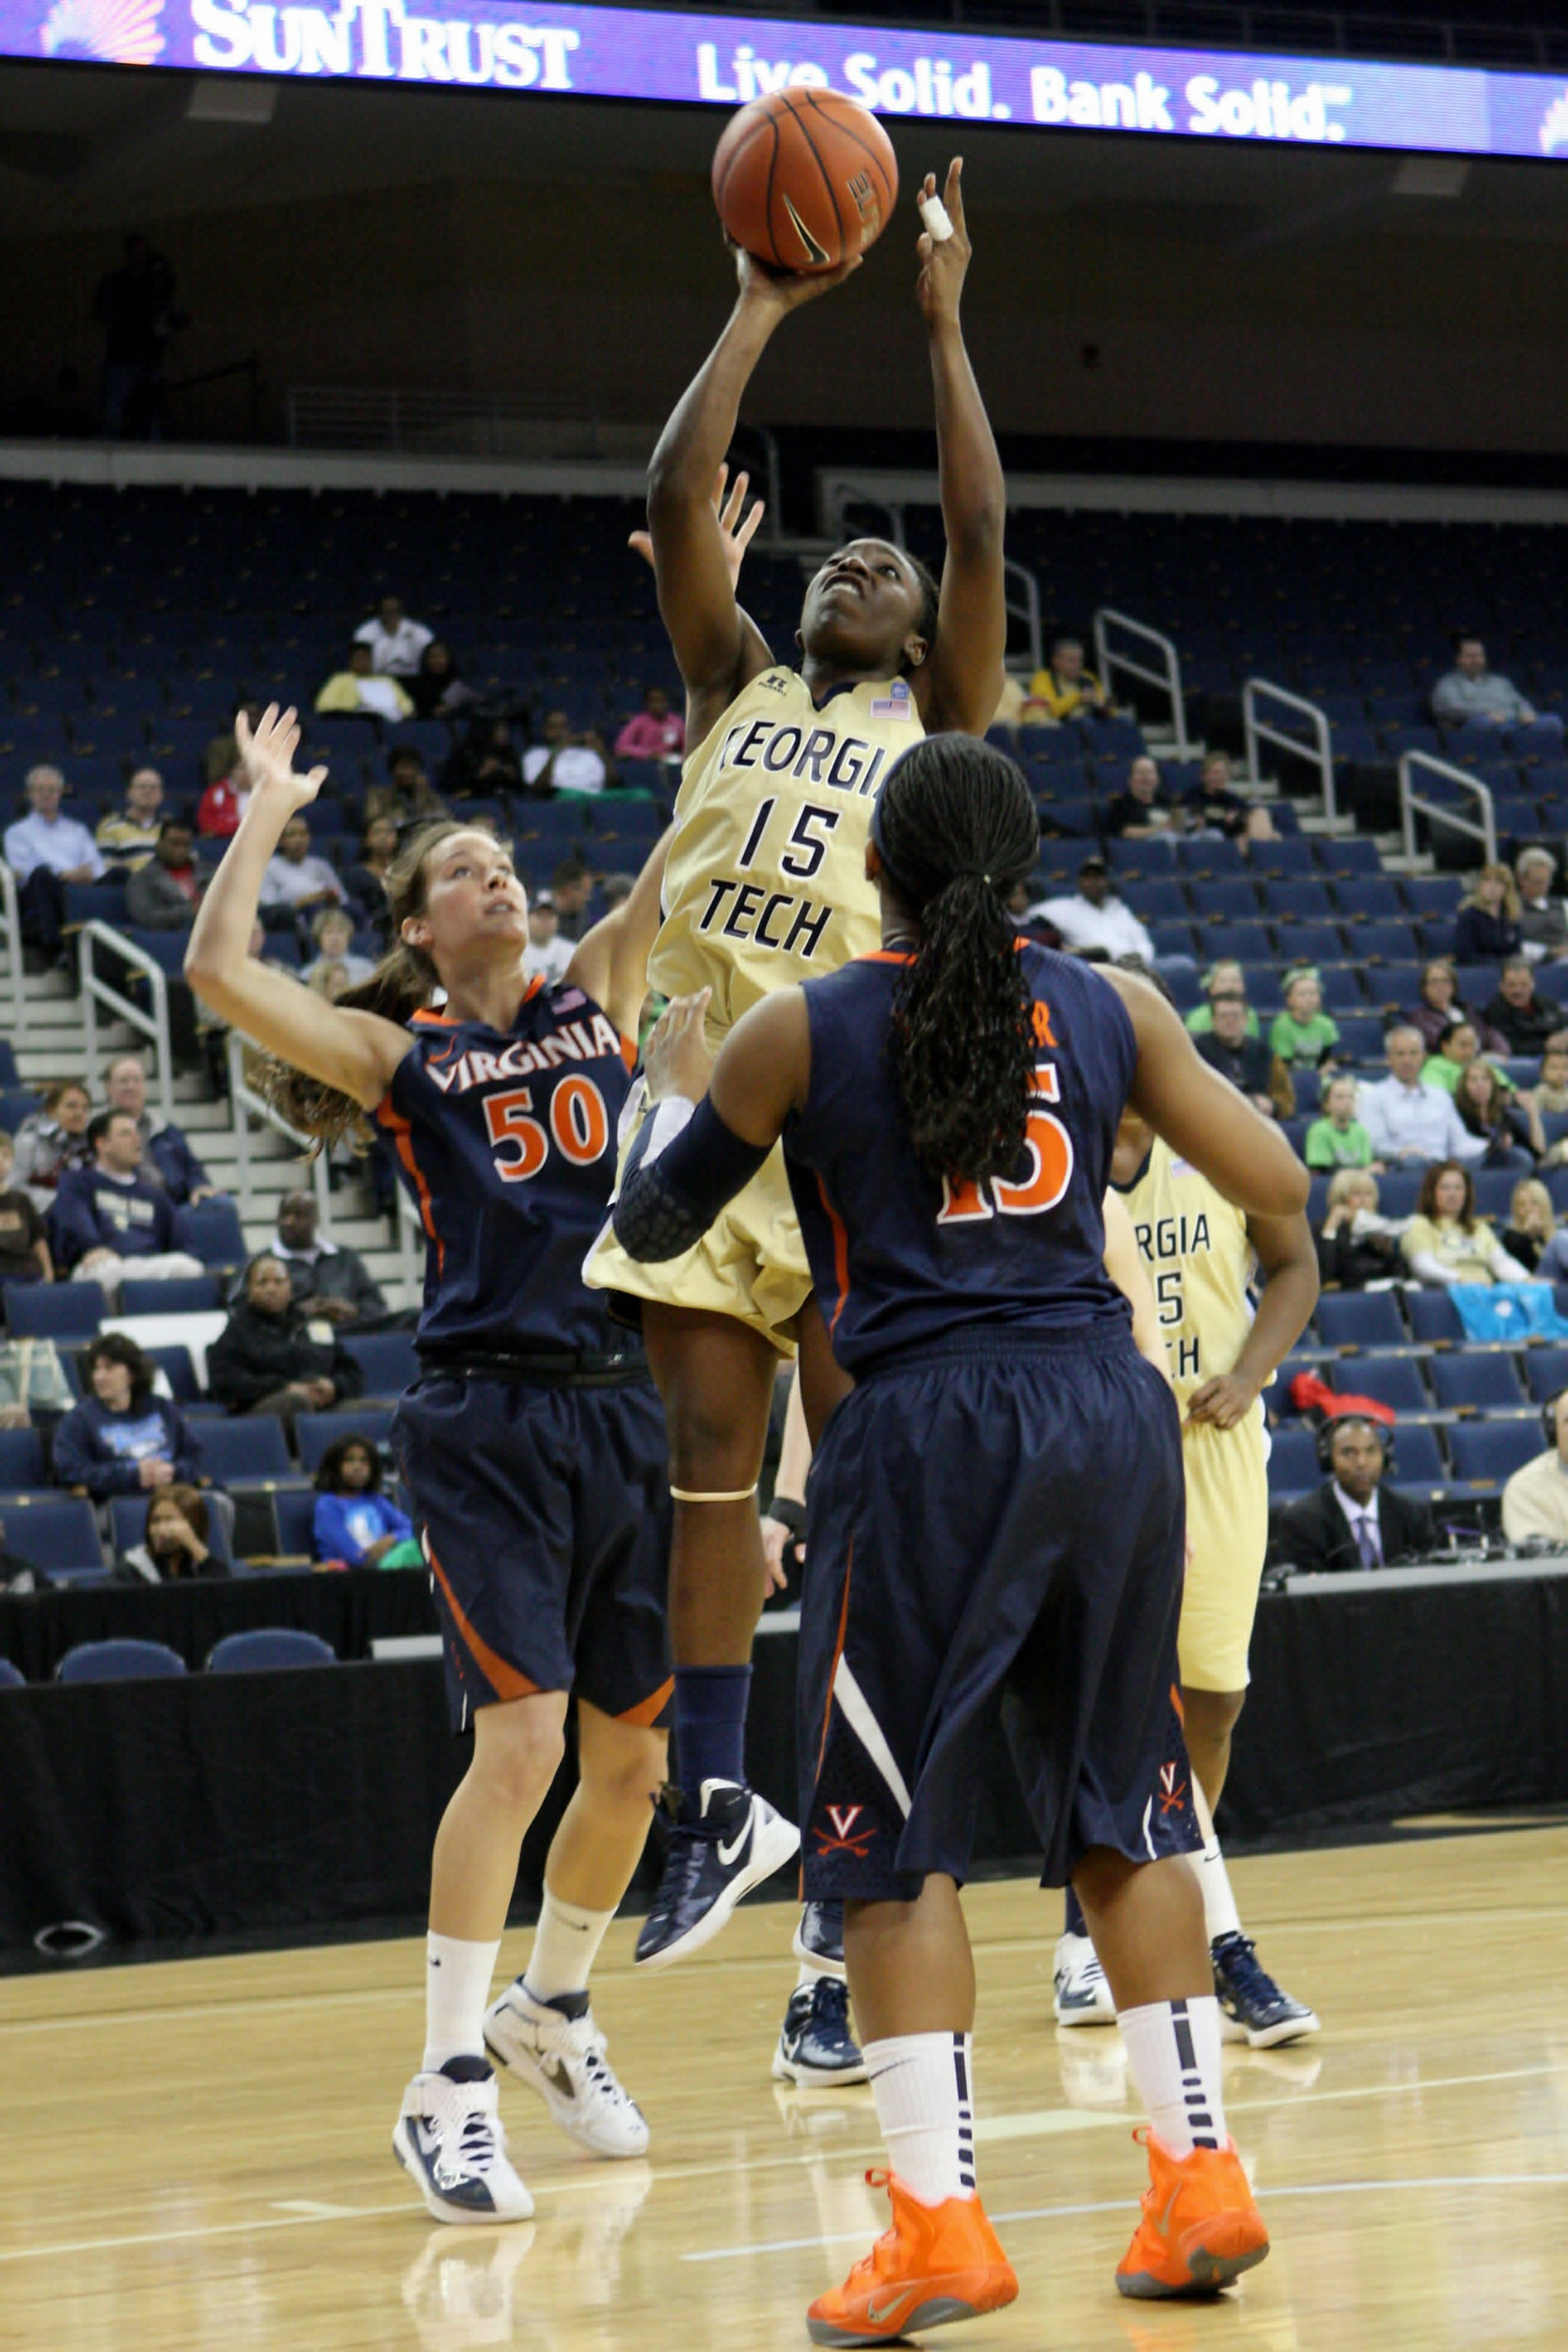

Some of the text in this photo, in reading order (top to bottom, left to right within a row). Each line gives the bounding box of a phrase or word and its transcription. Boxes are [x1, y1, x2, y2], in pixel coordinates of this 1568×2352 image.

[697, 43, 829, 102] Live
[844, 53, 1012, 119] Solid.
[1030, 66, 1174, 130] Bank
[719, 721, 886, 800] EORGI
[738, 798, 841, 879] 15
[700, 878, 832, 959] TECH
[425, 1014, 621, 1093] VIRGINIA
[483, 1074, 610, 1183] 50
[937, 1063, 1074, 1224] 5
[1134, 1213, 1211, 1262] RGIA
